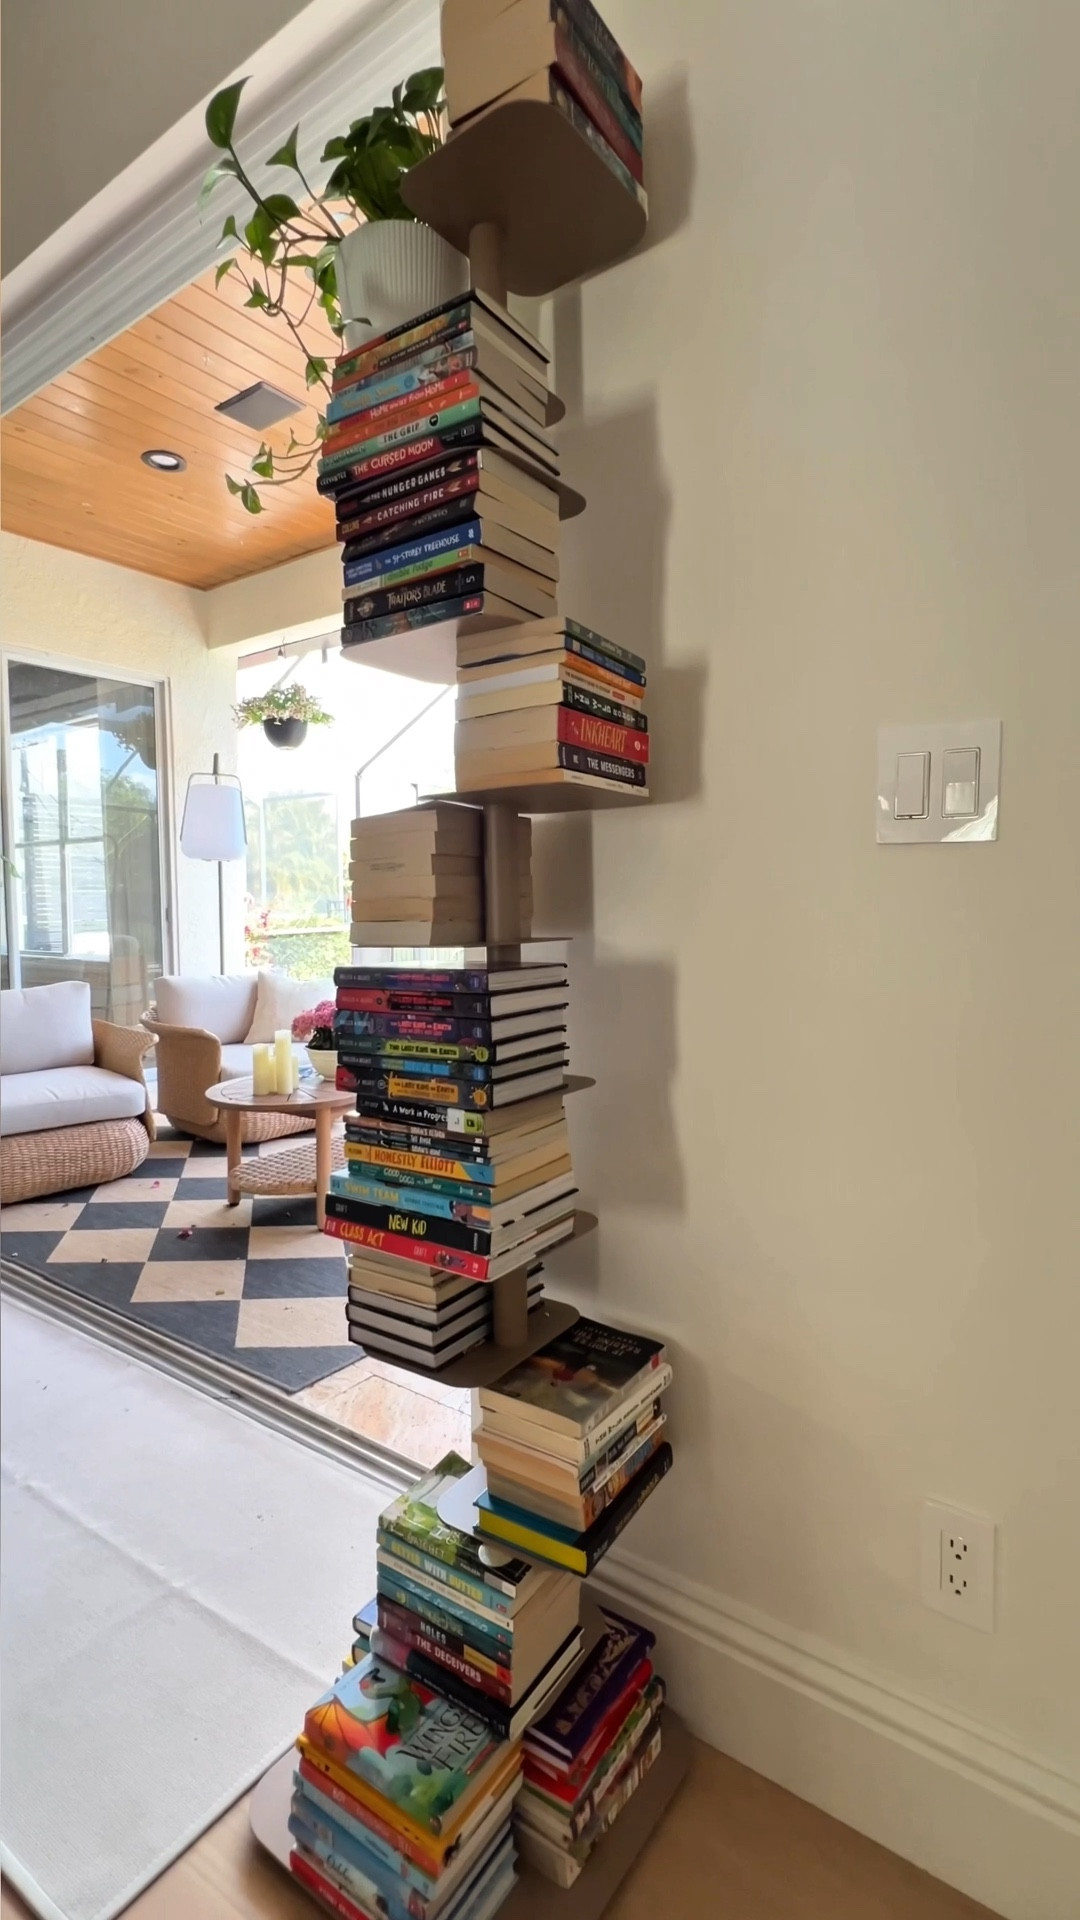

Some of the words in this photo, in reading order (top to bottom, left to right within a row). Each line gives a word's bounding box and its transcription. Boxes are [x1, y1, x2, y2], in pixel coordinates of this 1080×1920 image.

[384, 433, 397, 443] THE
[400, 422, 419, 437] GRIP
[352, 464, 369, 476] THE
[371, 449, 406, 469] CURSED
[408, 438, 434, 456] MOON
[382, 477, 416, 498] HUNGER
[418, 466, 446, 485] GAMES
[377, 497, 420, 521] CATCHING
[423, 487, 444, 504] FIRE
[423, 533, 460, 553] TREEHOUSE
[387, 590, 422, 610] TRAITOR'S
[422, 581, 447, 599] BLADE
[574, 692, 590, 705] THE
[592, 698, 612, 714] WILD
[580, 718, 628, 753] INKHEART
[587, 757, 599, 770] THE
[601, 761, 635, 779] MESSENGERS
[393, 1105, 398, 1113] A
[399, 1106, 415, 1116] Work
[417, 1108, 422, 1117] in
[423, 1111, 448, 1122] Progre
[374, 1150, 419, 1168] HONESTLY
[420, 1156, 456, 1174] ELLIOTT
[383, 1167, 400, 1177] GOOD
[399, 1174, 415, 1185] DOGS
[346, 1183, 370, 1195] SWIM
[374, 1187, 399, 1202] TEAM
[339, 1222, 364, 1240] CLASS
[367, 1229, 385, 1247] ACT
[388, 1213, 408, 1231] NEW
[411, 1219, 427, 1235] KID
[406, 1531, 445, 1558] HATCHET
[423, 1558, 447, 1581] WITH
[420, 1621, 446, 1645] HOLES
[416, 1634, 432, 1653] THE
[434, 1646, 482, 1683] DECEIVERS
[432, 1713, 489, 1772] FIRE
